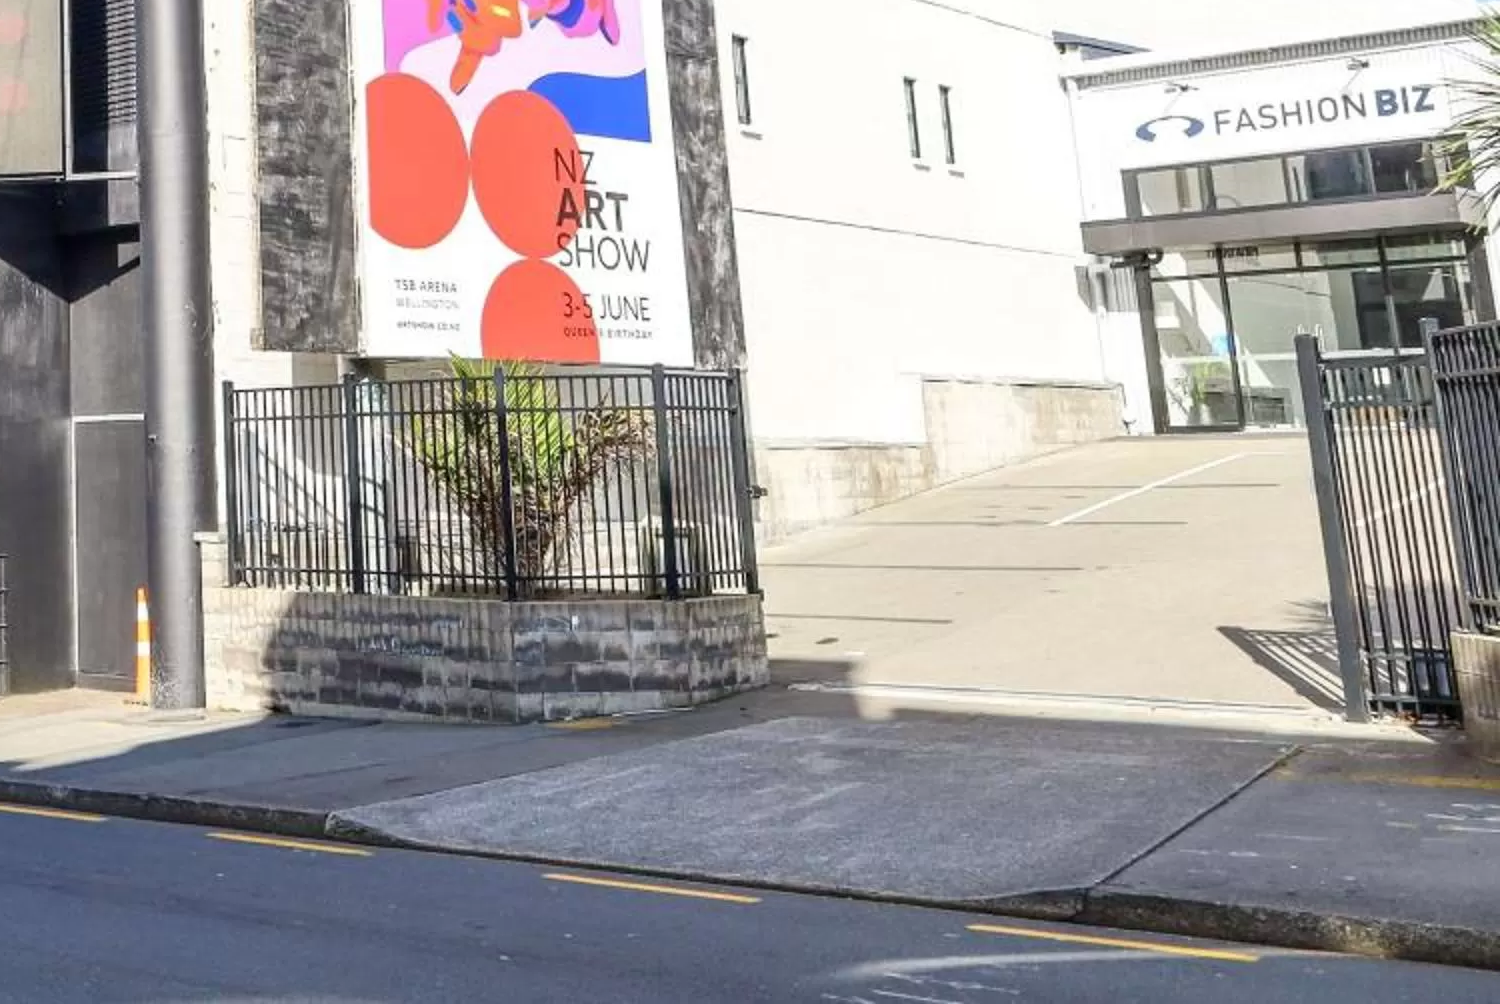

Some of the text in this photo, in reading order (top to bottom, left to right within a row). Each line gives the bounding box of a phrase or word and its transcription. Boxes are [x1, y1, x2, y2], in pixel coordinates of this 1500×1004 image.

[1213, 86, 1436, 135] FASHION BIZ
[554, 147, 597, 185] NZ
[555, 187, 629, 232] ART
[557, 232, 651, 273] SHOW
[419, 280, 458, 294] ARENA
[562, 291, 652, 322] 3-5 JUNE
